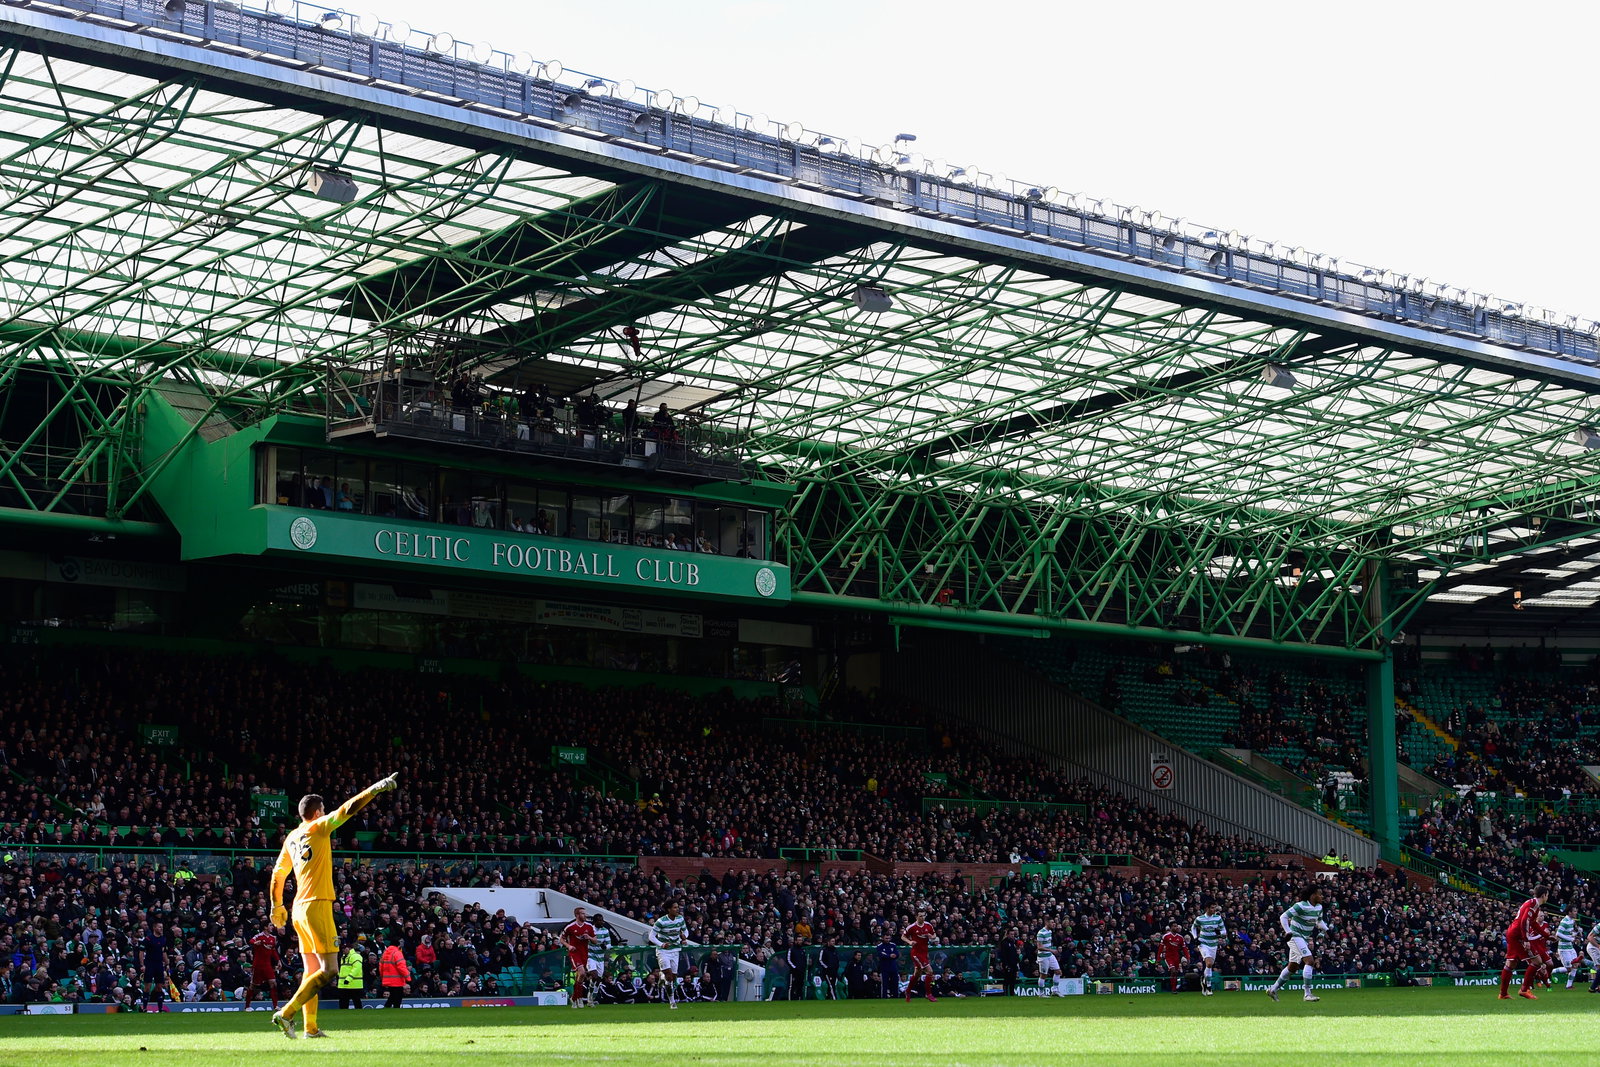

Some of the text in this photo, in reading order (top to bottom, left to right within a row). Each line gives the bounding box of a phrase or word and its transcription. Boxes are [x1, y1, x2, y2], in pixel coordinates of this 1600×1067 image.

[374, 529, 700, 586] CELTIC FOOTBALL CLUB
[152, 729, 169, 737] EXIT
[264, 800, 282, 809] EXIT
[1118, 985, 1156, 994] MAGNERS
